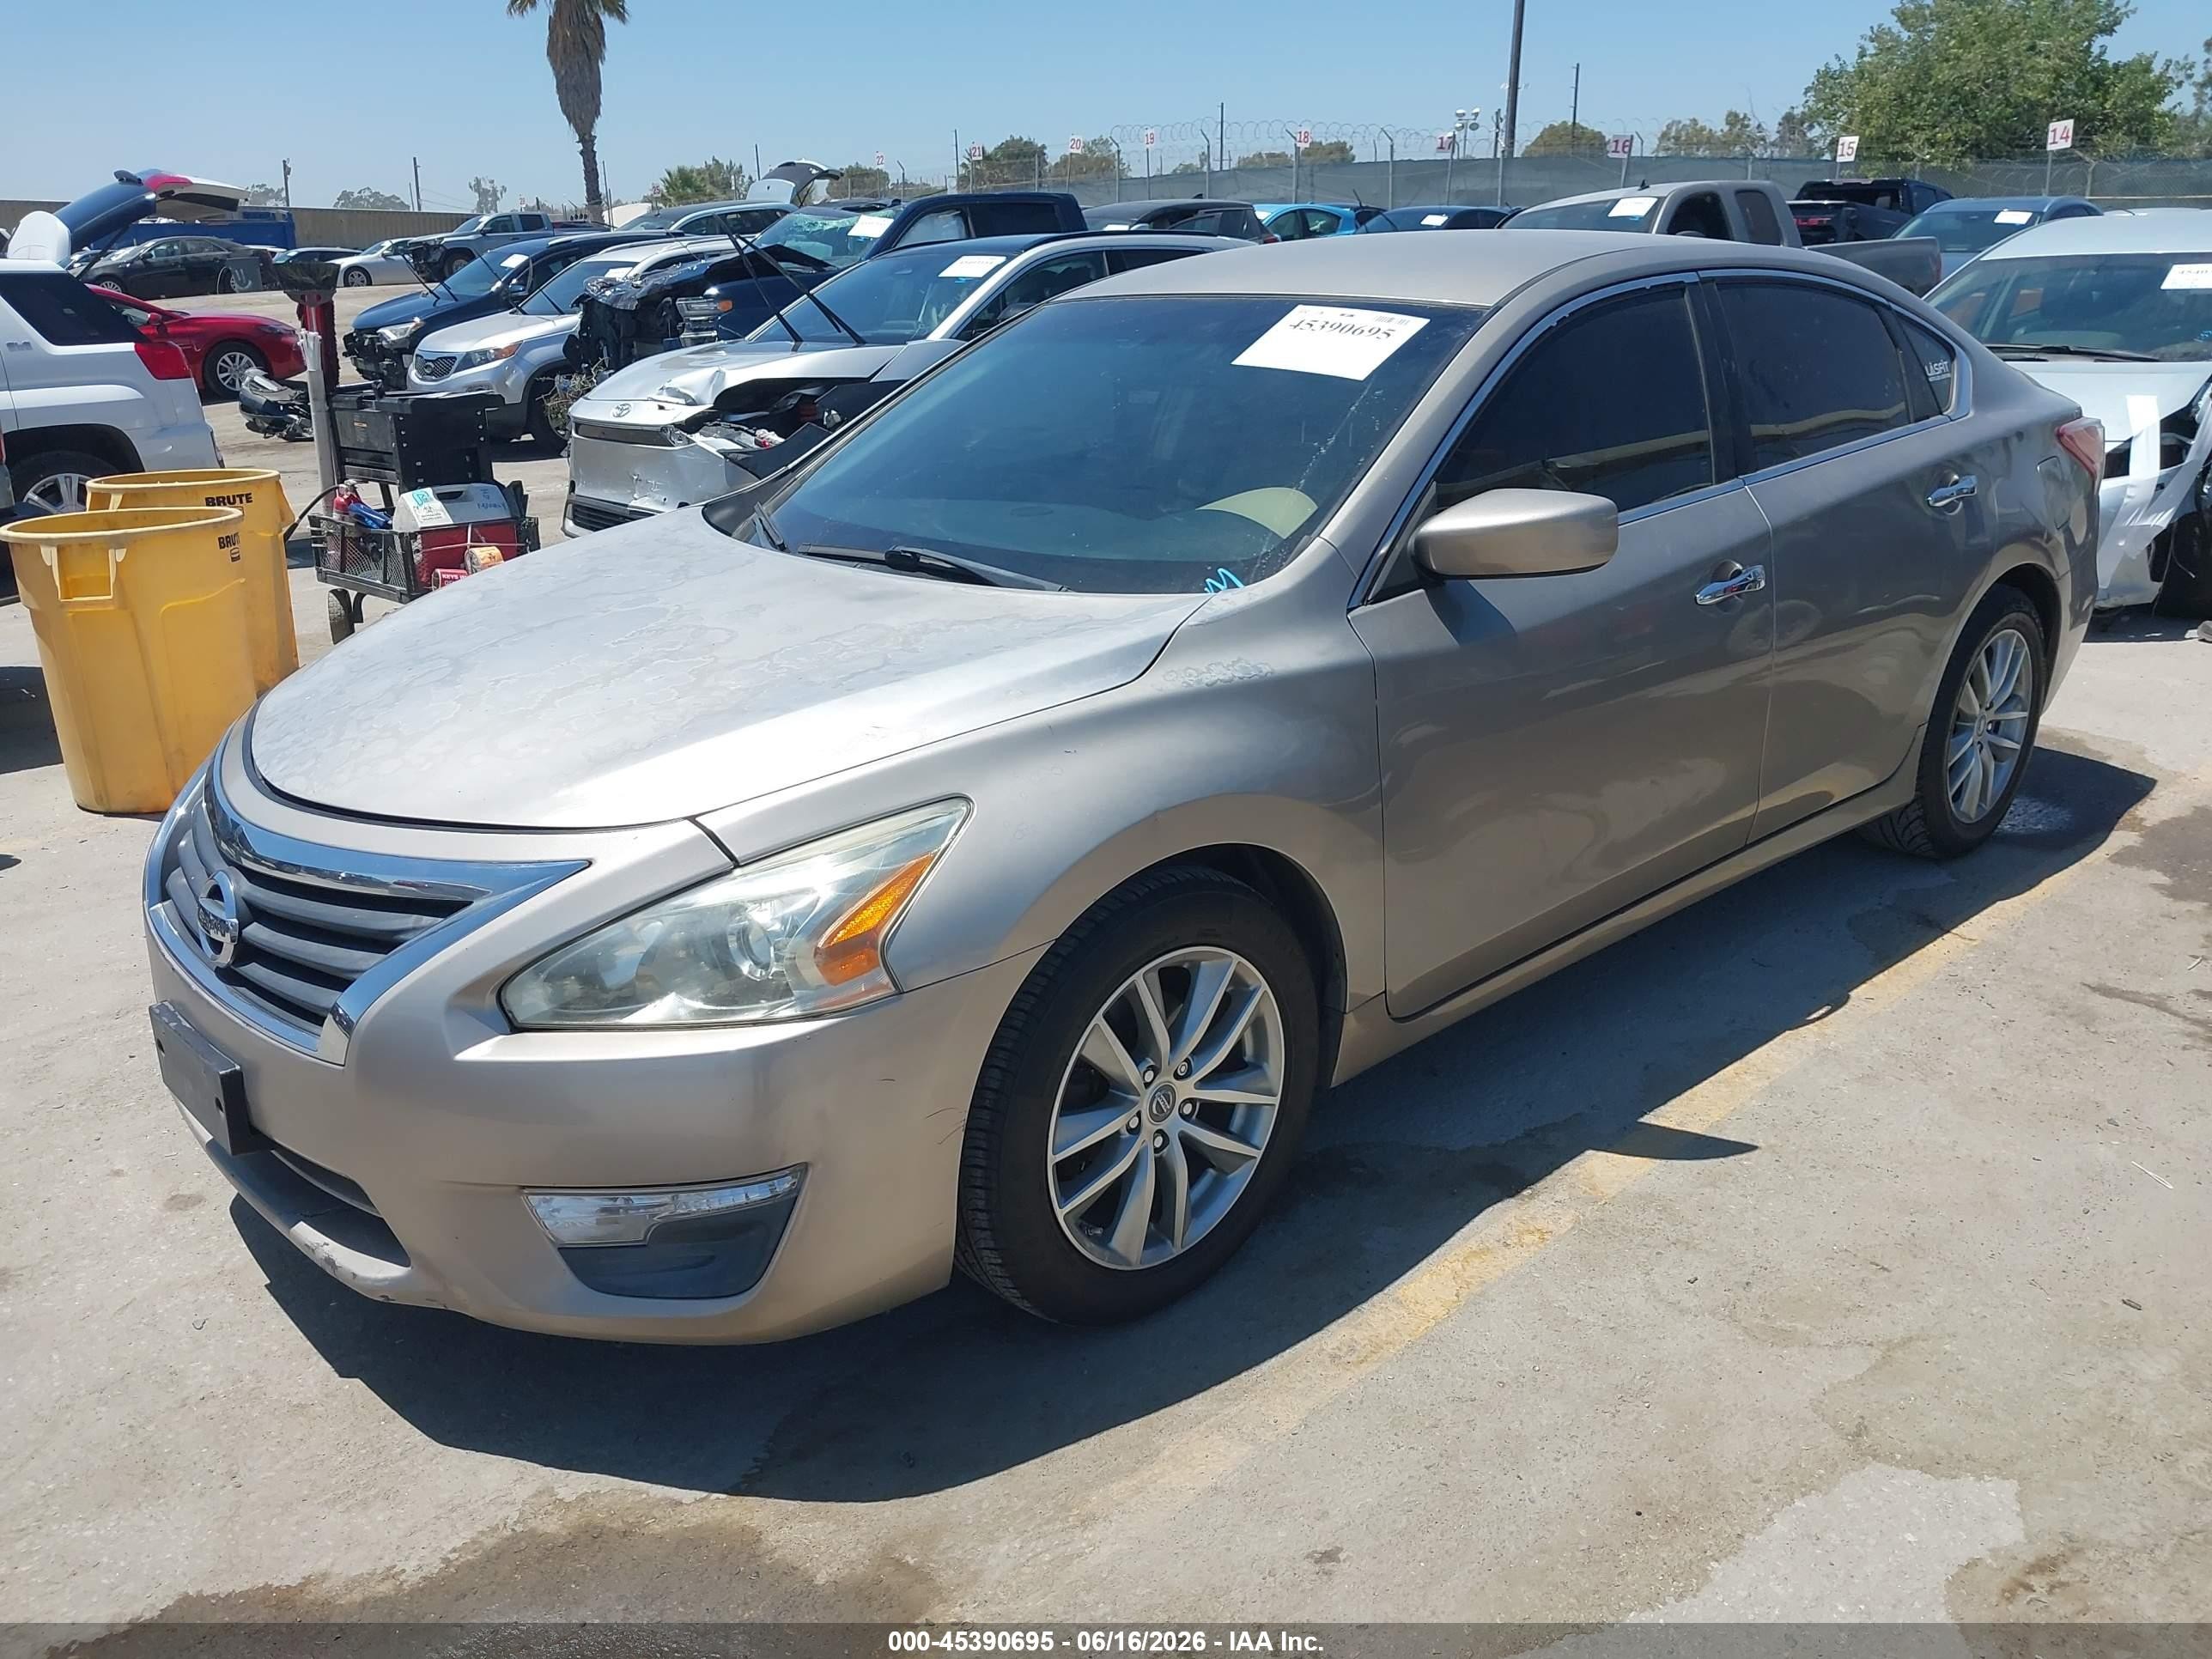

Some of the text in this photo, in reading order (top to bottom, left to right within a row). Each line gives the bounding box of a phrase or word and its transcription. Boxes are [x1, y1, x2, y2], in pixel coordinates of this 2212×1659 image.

[1146, 133, 1155, 144] 19
[1297, 131, 1310, 143] 18
[2049, 125, 2070, 145] 14
[1070, 137, 1081, 149] 20
[1437, 136, 1453, 150] 17
[1611, 139, 1630, 154] 16
[1838, 141, 1855, 157] 15
[971, 146, 981, 157] 21
[876, 155, 884, 166] 22
[652, 185, 660, 195] 25
[1289, 319, 1396, 340] 45390695
[205, 492, 253, 507] BRUTE
[218, 532, 240, 550] BRUT
